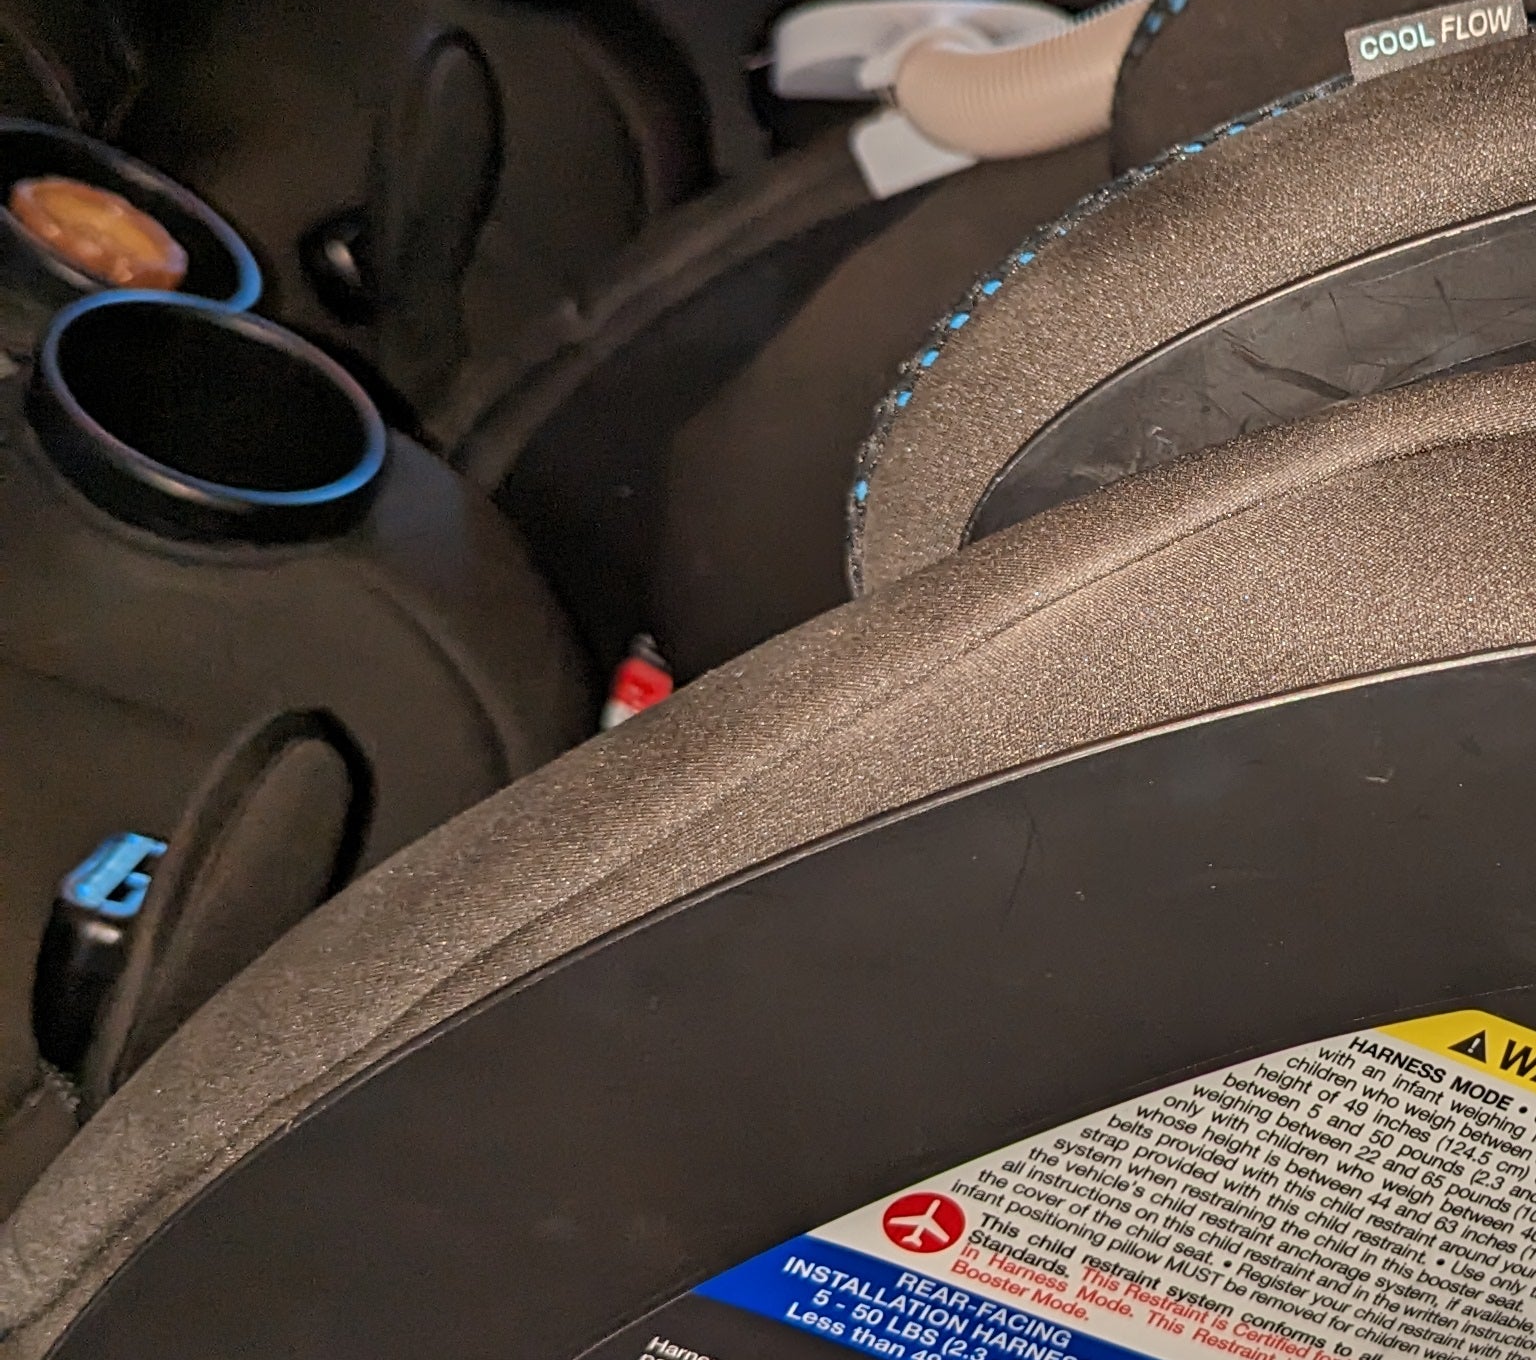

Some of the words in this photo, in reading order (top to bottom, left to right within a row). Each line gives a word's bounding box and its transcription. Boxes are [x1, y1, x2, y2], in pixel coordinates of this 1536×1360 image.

[1360, 22, 1436, 61] COOL
[1441, 6, 1512, 43] FLOW
[1348, 1036, 1446, 1083] HARNESS
[1449, 1076, 1514, 1111] MODE
[783, 1256, 969, 1334] INSTALLATION
[813, 1289, 832, 1306] 5
[852, 1303, 883, 1325] 50
[886, 1316, 939, 1346] LBS
[896, 1272, 1071, 1348] REAR-FACING
[981, 1212, 1020, 1238] This
[1027, 1235, 1077, 1259] child
[1081, 1254, 1161, 1290] restraint
[1164, 1286, 1234, 1317] system
[1241, 1313, 1327, 1349] conforms
[1333, 1342, 1352, 1357] to
[786, 1302, 845, 1335] Less
[851, 1327, 905, 1358] than
